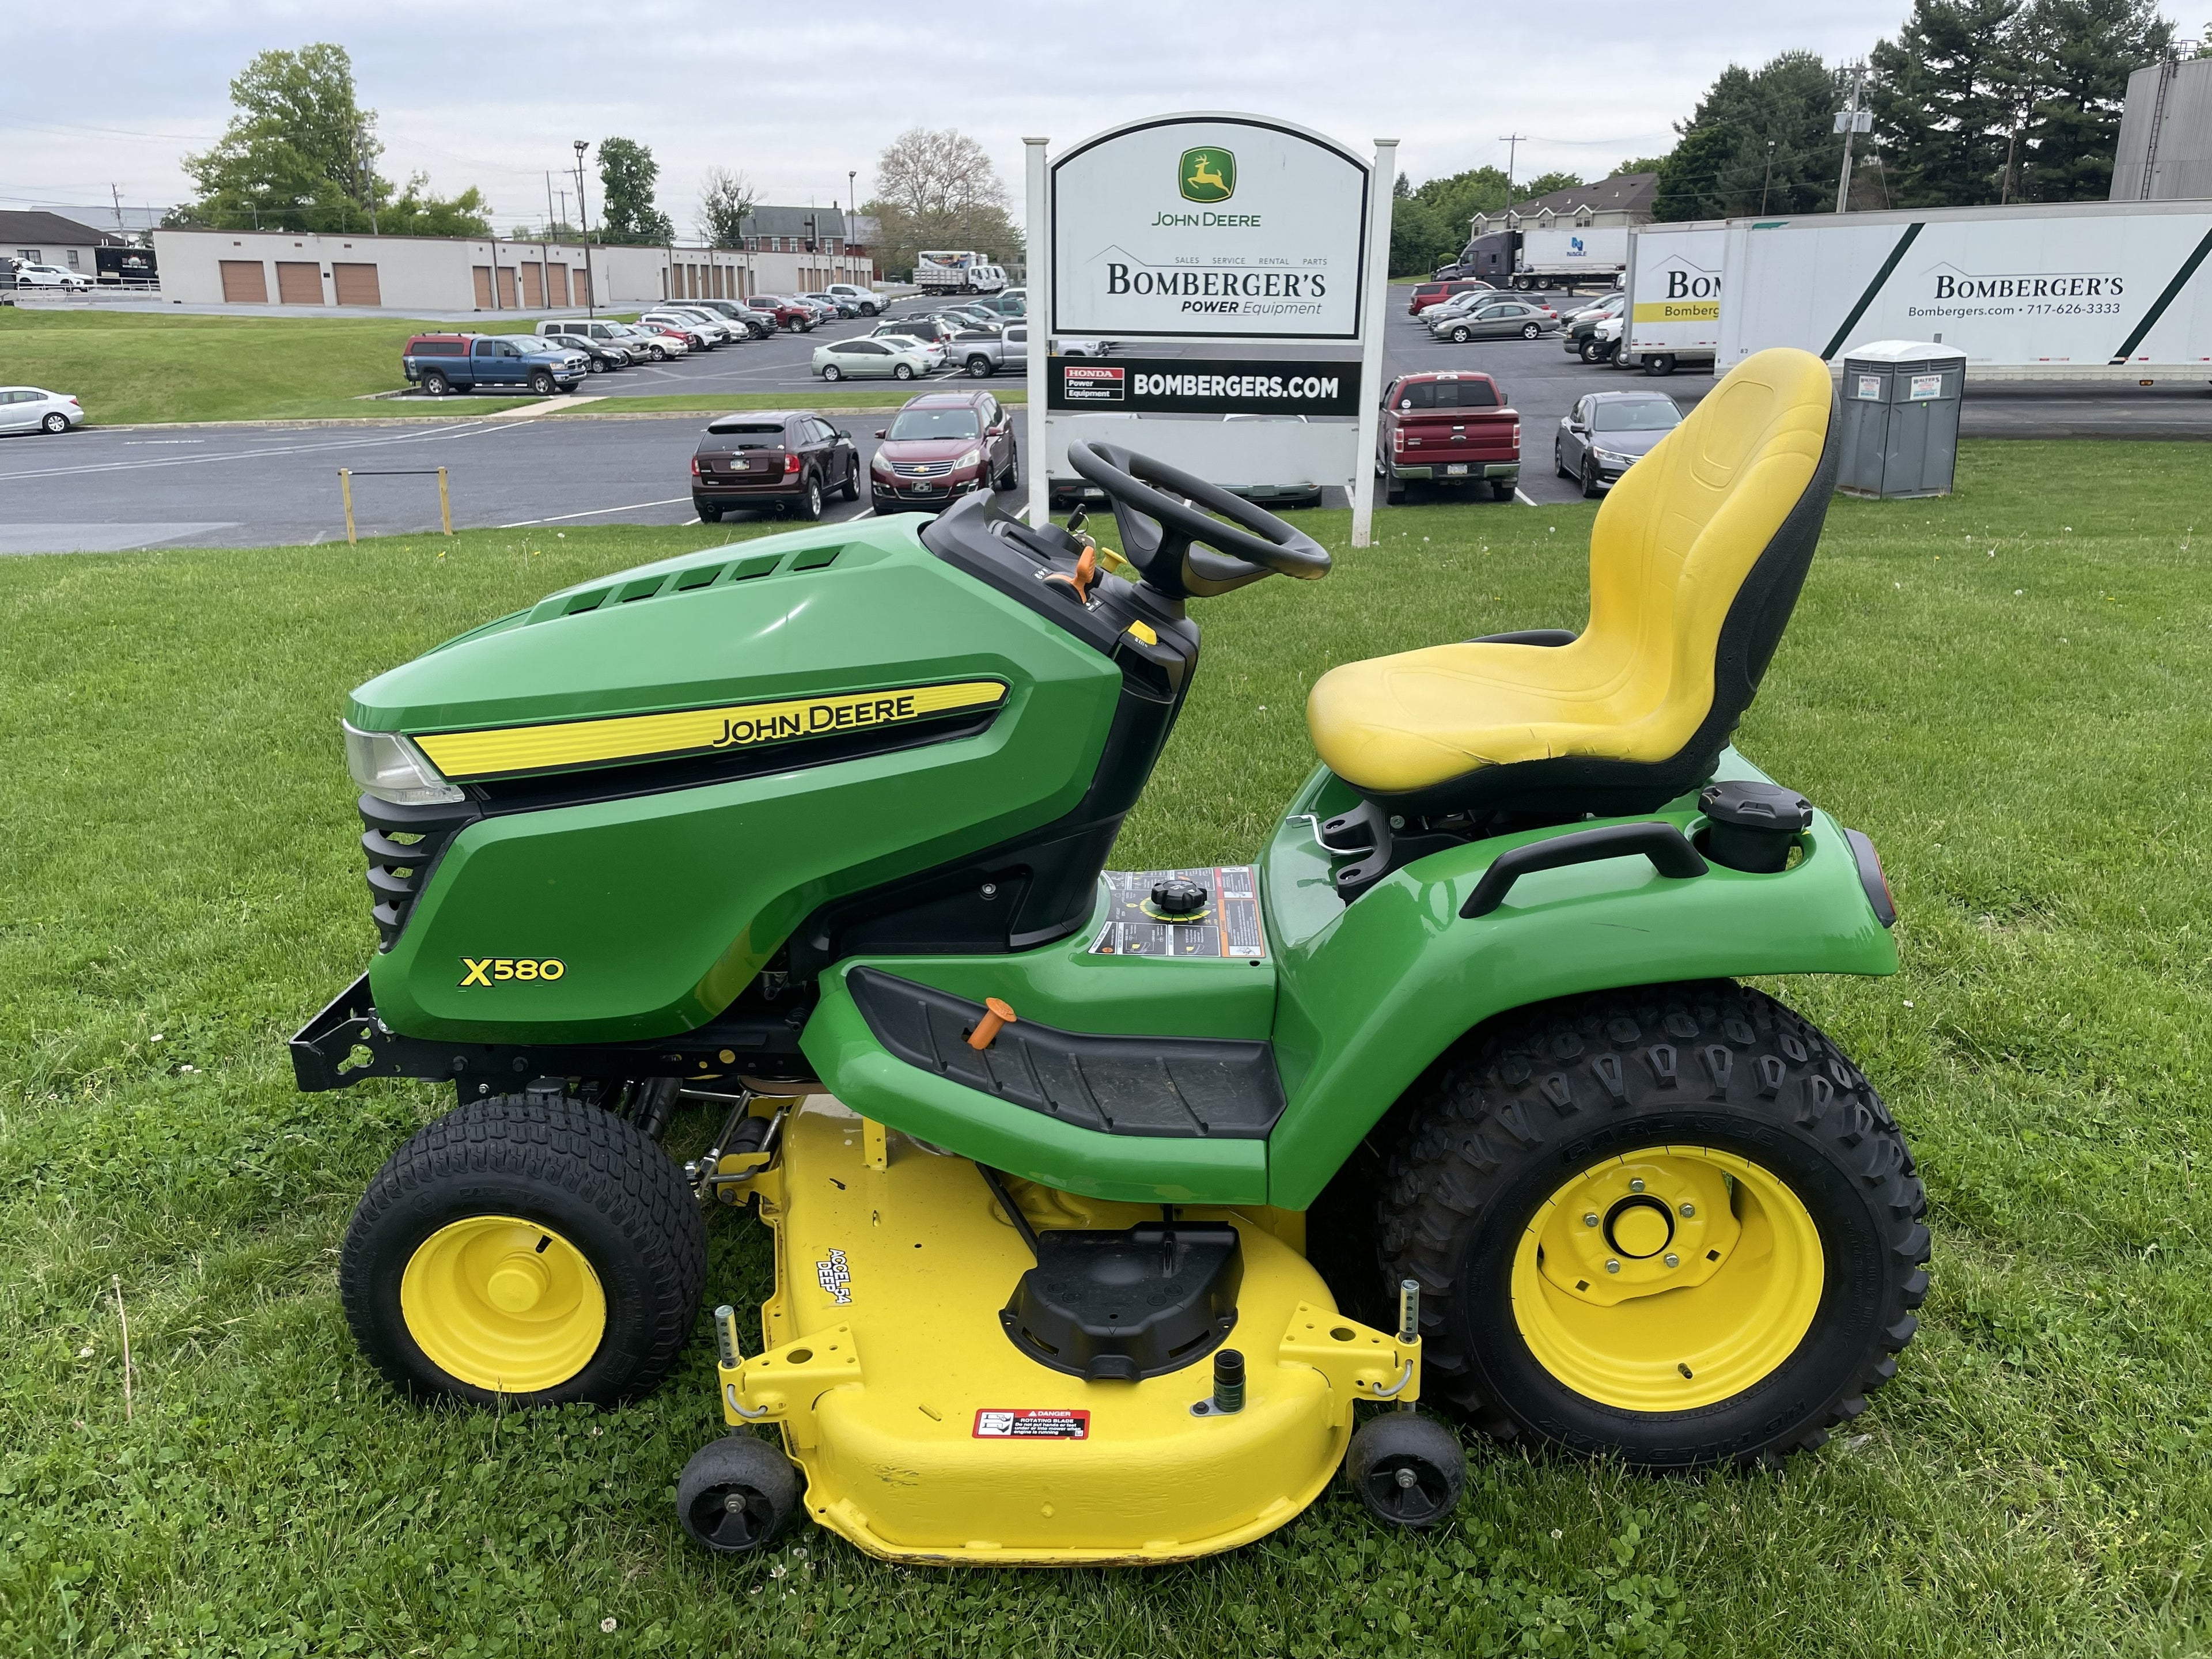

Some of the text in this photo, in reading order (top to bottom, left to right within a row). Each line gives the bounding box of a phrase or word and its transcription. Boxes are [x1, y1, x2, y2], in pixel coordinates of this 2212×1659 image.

[1152, 211, 1261, 228] JOHN DEERE
[1175, 256, 1199, 264] SALES
[1107, 263, 1326, 298] BOMBERGER'S
[1934, 275, 2124, 299] BOMBERGER'S
[1181, 301, 1323, 316] POWER Equipment
[1908, 303, 2121, 318] Bombergers.com 717-626-3333
[1134, 373, 1339, 399] BOMBERGERS.COM
[713, 695, 917, 747] JOHN DEERE
[458, 957, 565, 987] X580
[1560, 1115, 1783, 1165] CARLISLE
[816, 1260, 836, 1293] DEEP
[828, 1248, 852, 1303] ACCEL 54
